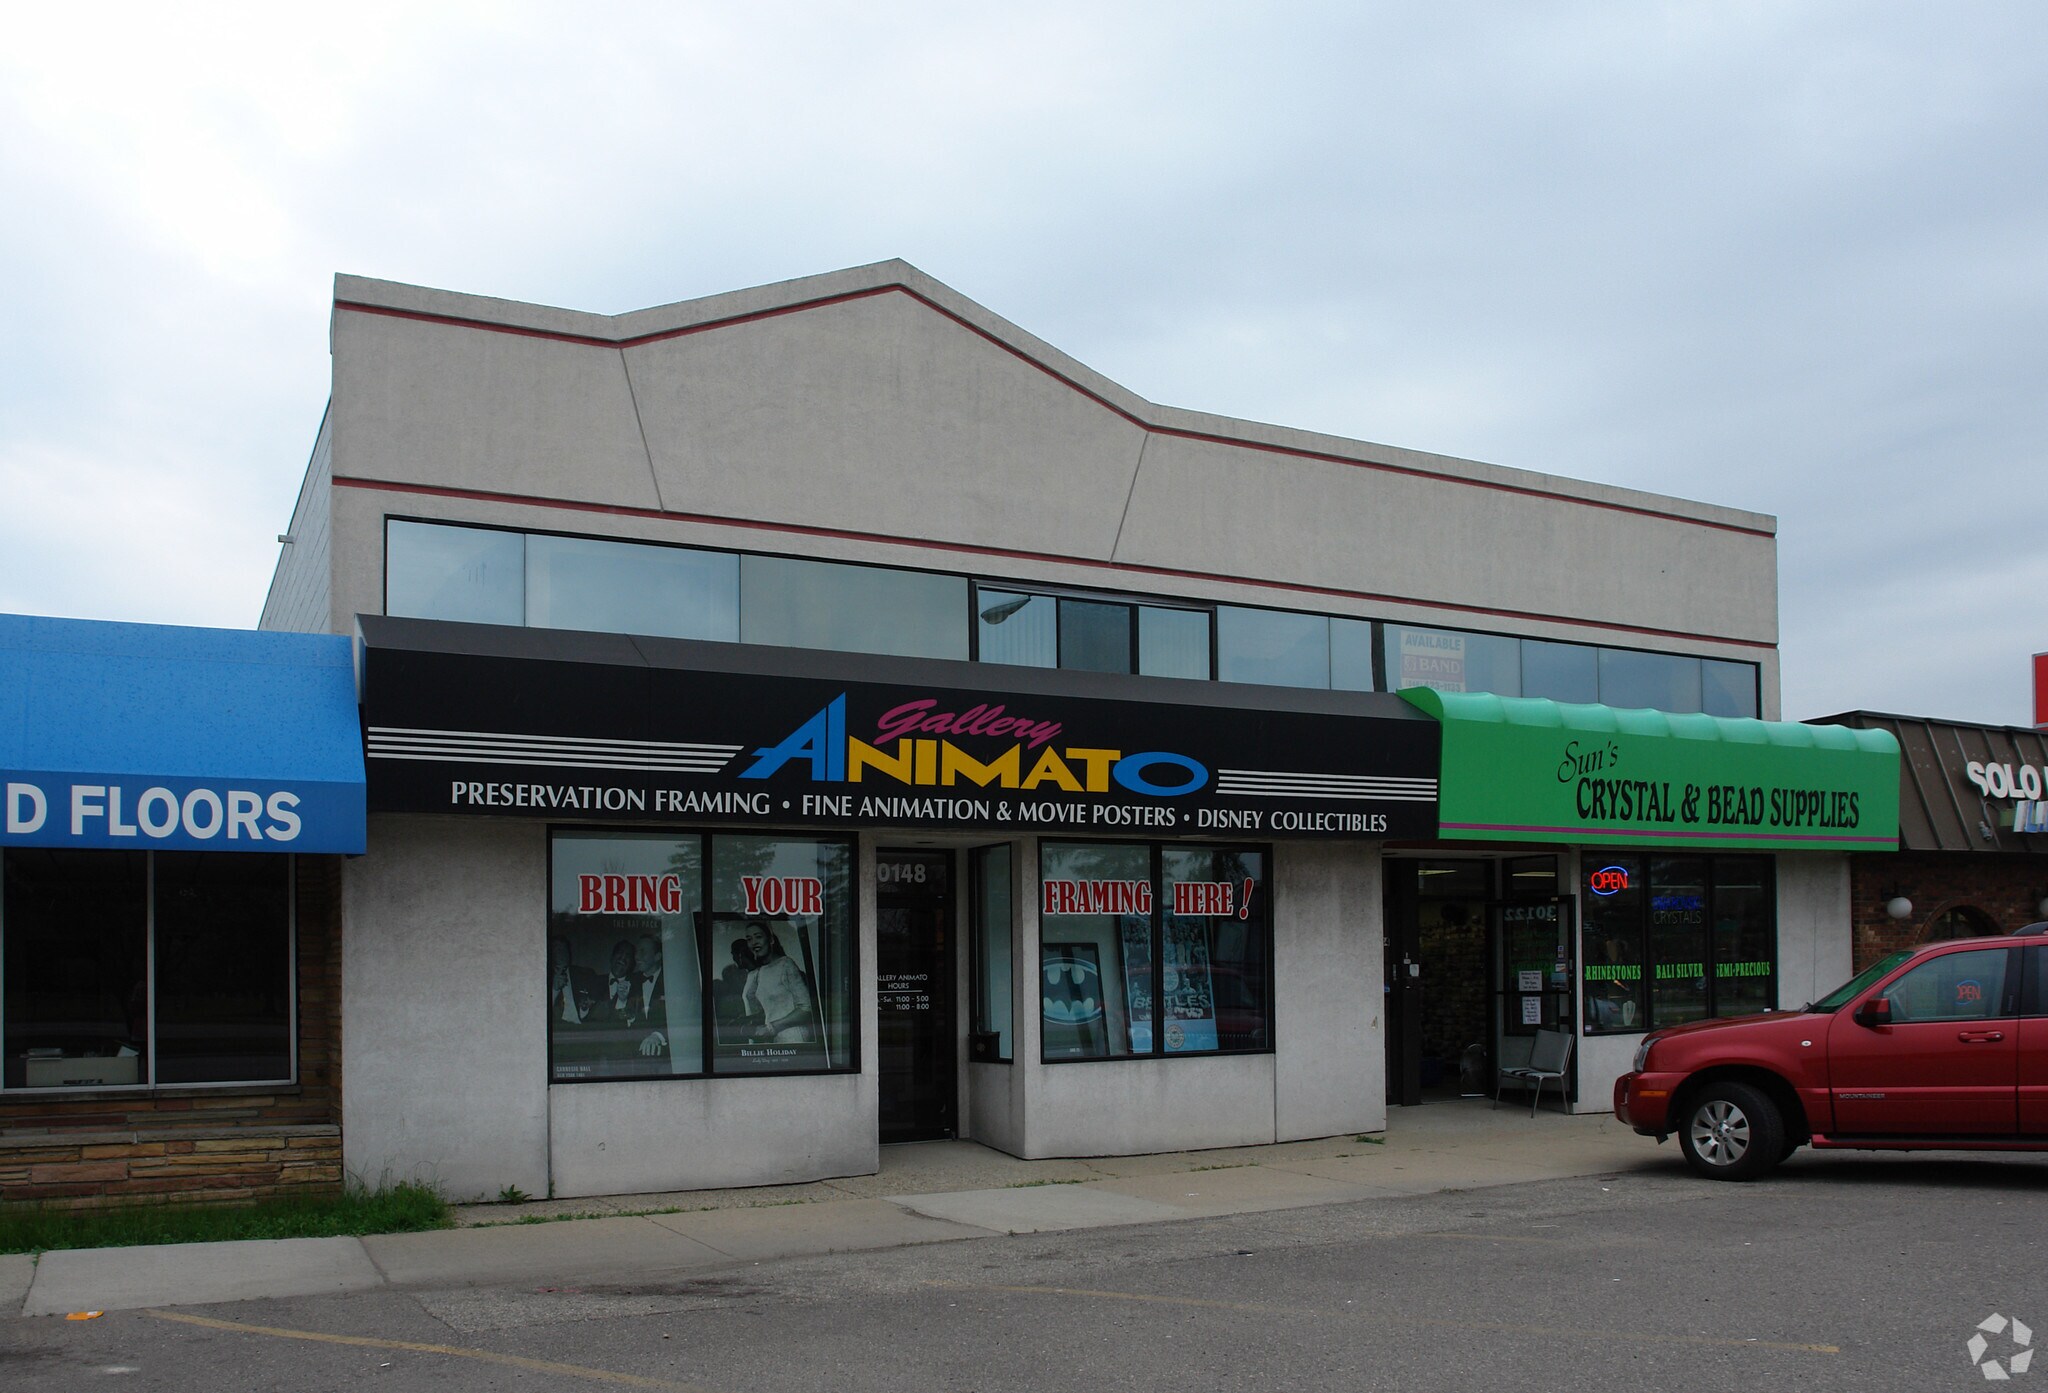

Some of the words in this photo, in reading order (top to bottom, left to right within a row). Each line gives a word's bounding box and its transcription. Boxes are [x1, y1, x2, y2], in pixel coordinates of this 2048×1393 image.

[1405, 633, 1461, 651] AVAILABLE
[737, 691, 1209, 796] ANIMATO
[873, 698, 1063, 750] Gallery
[1557, 740, 1619, 783] Sun's
[1967, 761, 2042, 800] SOLO
[6, 782, 48, 834] D
[71, 784, 302, 842] FLOORS
[451, 781, 646, 812] PRESERVATION
[655, 789, 771, 816] FRAMING
[801, 794, 853, 817] FINE
[858, 796, 991, 821] ANIMATION
[996, 801, 1013, 822] &
[1017, 802, 1087, 824] MOVIE
[1093, 804, 1176, 827] POSTERS
[1197, 808, 1264, 830] DISNEY
[1270, 810, 1388, 833] COLLECTIBLES
[1576, 777, 1675, 823] CRYSTAL
[1681, 783, 1701, 823] &
[1707, 785, 1764, 826] BEAD
[1769, 787, 1860, 829] SUPPLIES
[877, 863, 927, 883] 0148
[1590, 871, 1629, 891] OPEN
[578, 873, 682, 915] BRING
[741, 875, 824, 916] YOUR
[1043, 879, 1153, 916] FRAMING
[1653, 910, 1703, 924] CRYSTALS
[898, 973, 928, 981] ANIMATO
[1585, 964, 1642, 981] RHINESTONES
[1656, 964, 1675, 980] BALI
[1676, 962, 1704, 979] SILVER
